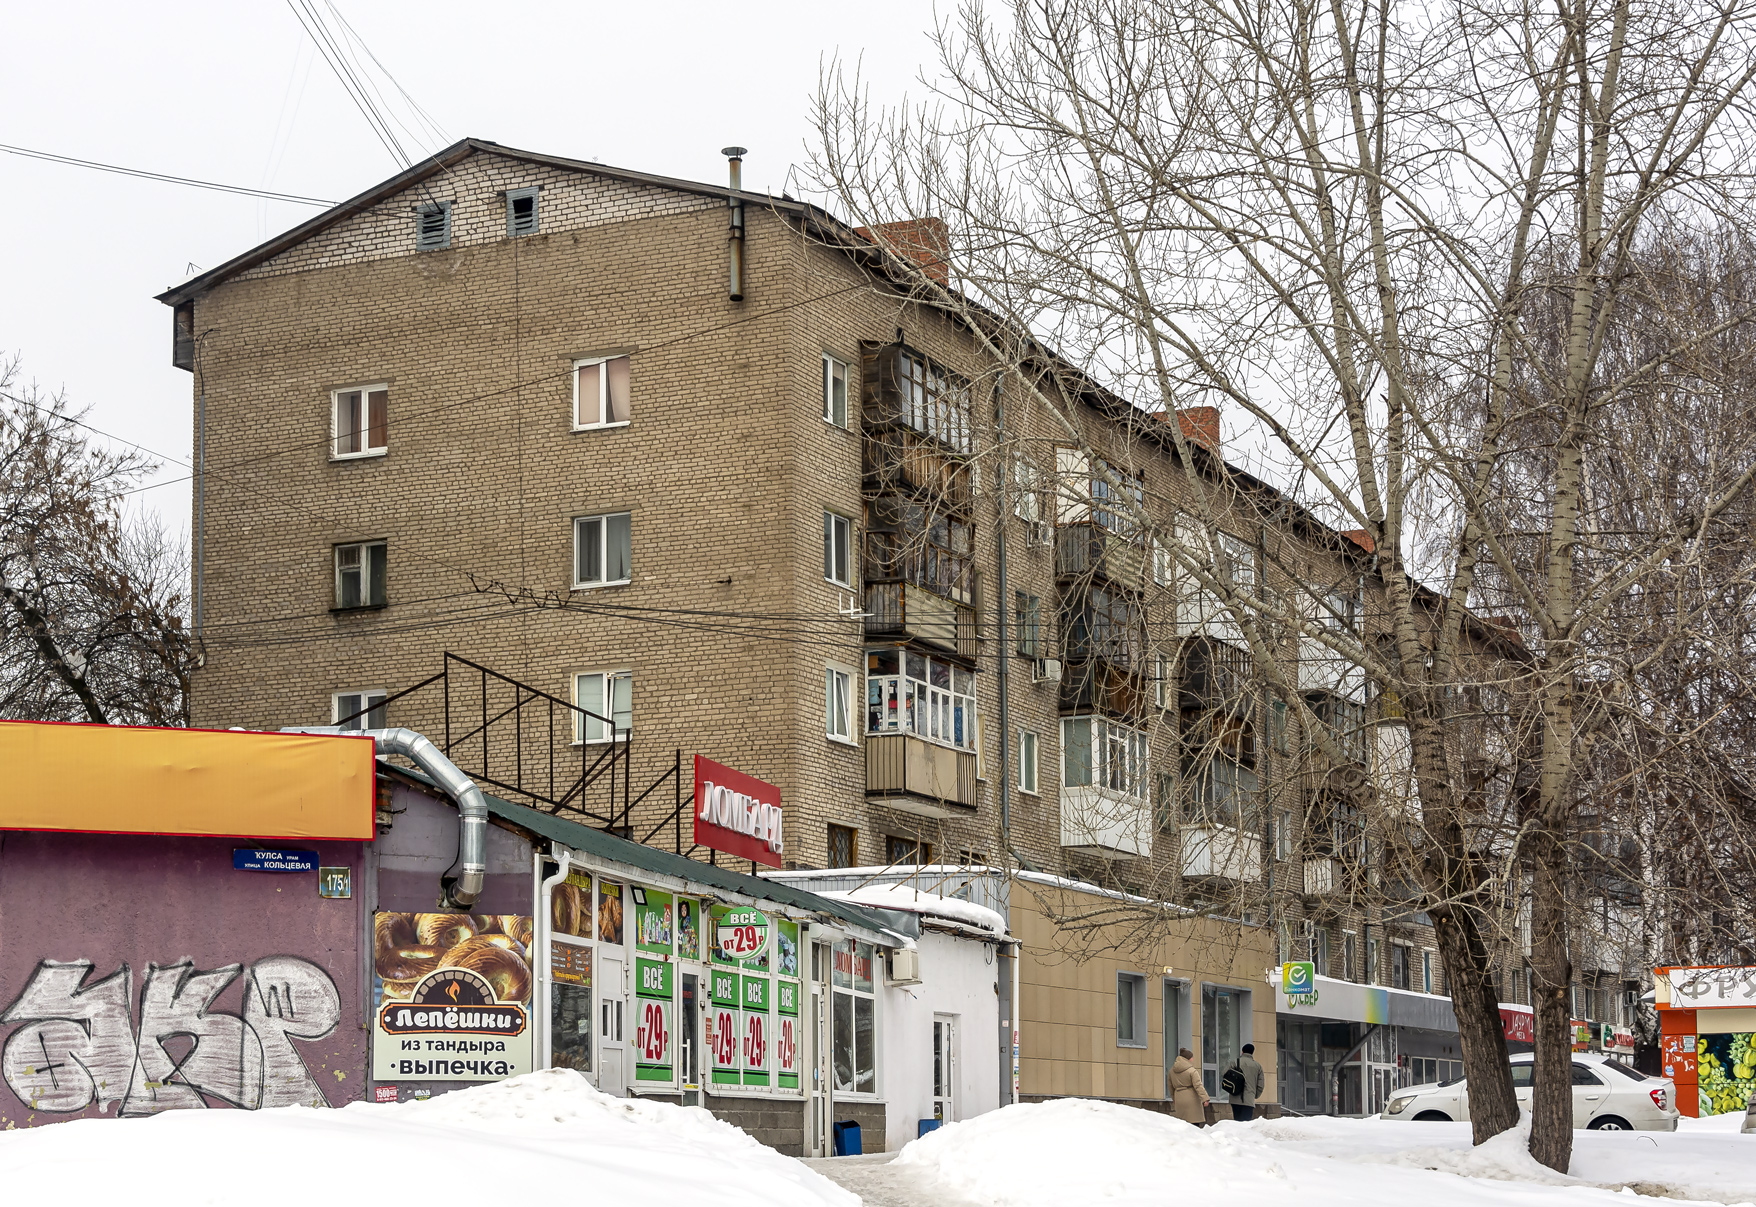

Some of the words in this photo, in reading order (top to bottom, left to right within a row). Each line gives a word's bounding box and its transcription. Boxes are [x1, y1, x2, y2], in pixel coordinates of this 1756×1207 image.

[264, 861, 311, 870] КОЛЬЦЕВАЯ
[730, 911, 757, 924] ВСЁ
[643, 964, 663, 990] ВСЁ
[716, 975, 732, 999] ВСЁ
[747, 980, 762, 1004] ВСЁ
[781, 985, 793, 1008] ВСЁ
[395, 1006, 512, 1029] Лепёшки
[401, 1040, 421, 1051] из
[425, 1040, 506, 1056] тандыра
